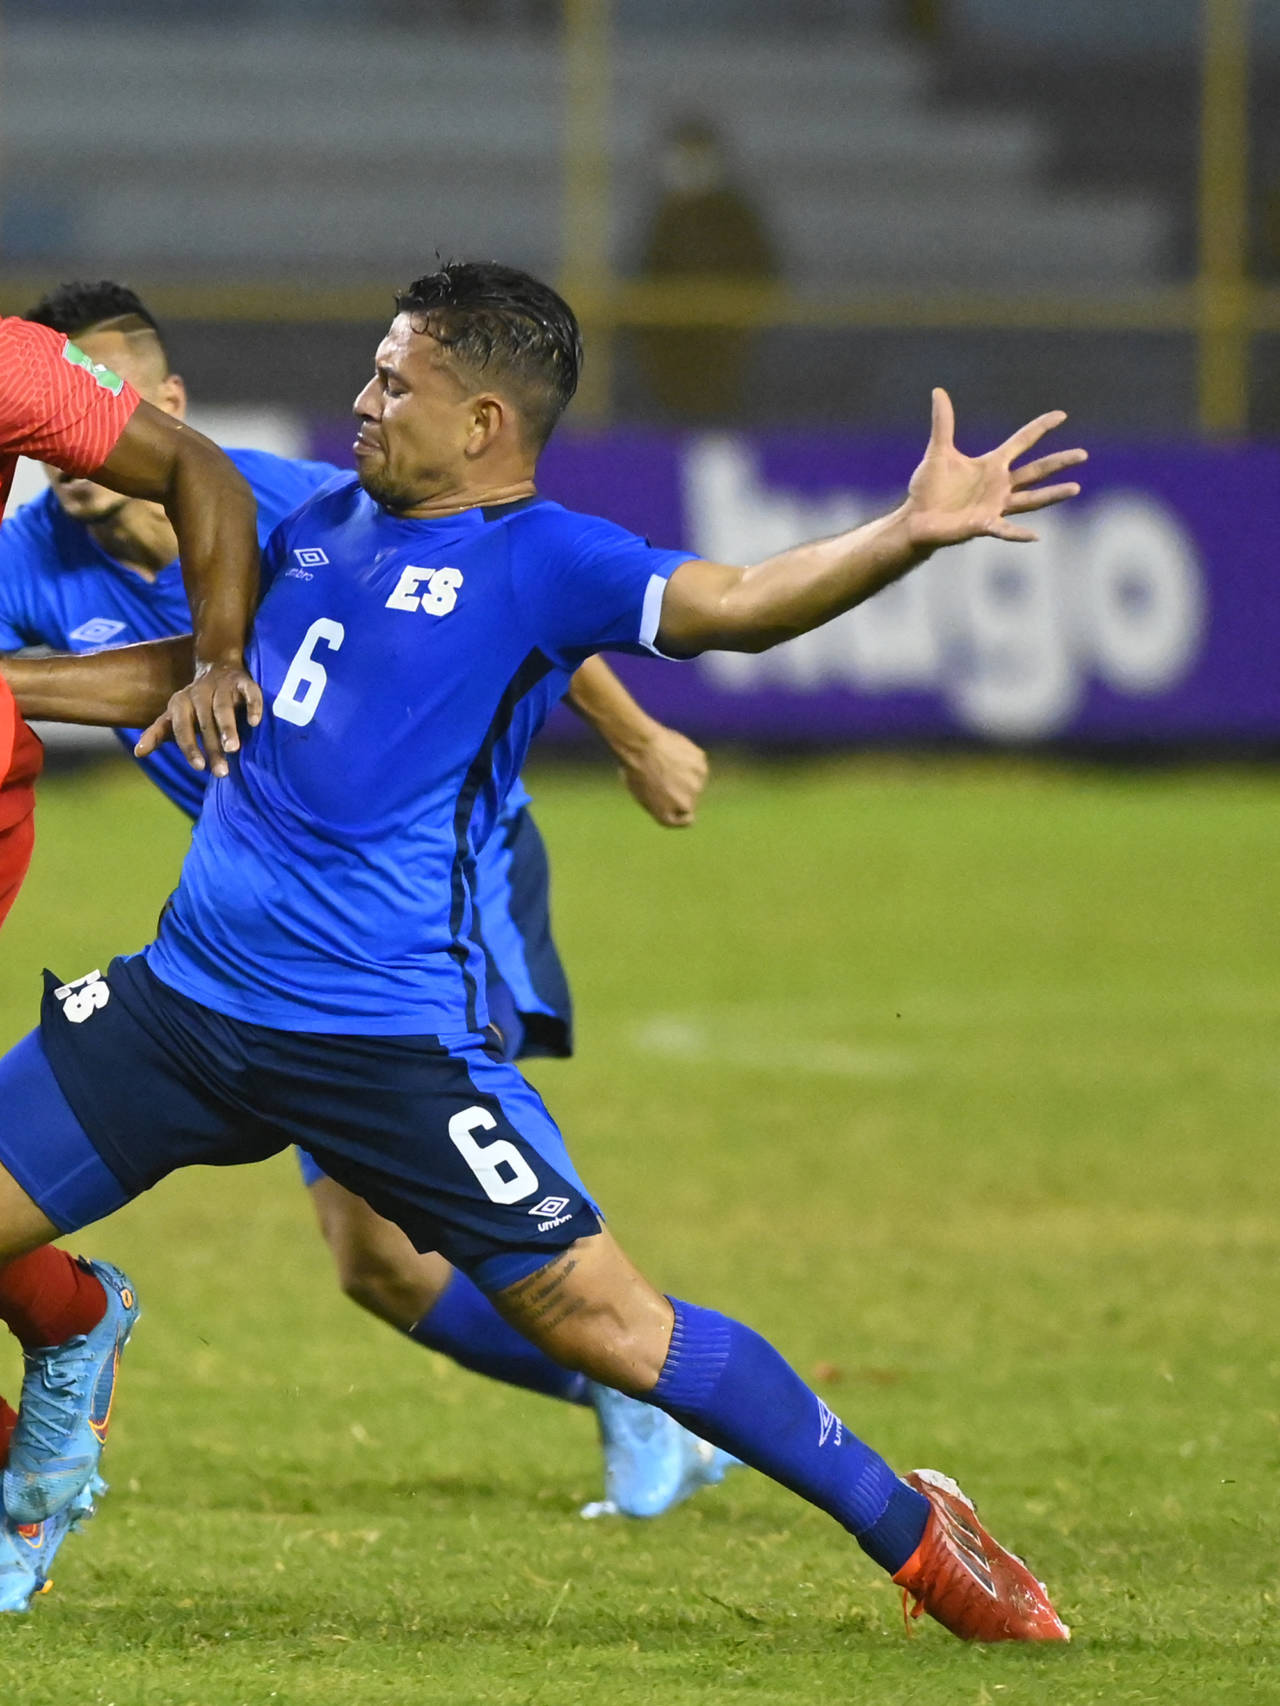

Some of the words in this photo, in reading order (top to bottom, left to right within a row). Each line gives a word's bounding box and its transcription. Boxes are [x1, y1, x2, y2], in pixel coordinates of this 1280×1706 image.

[384, 565, 464, 617] ES
[272, 617, 345, 727] 6
[448, 1105, 539, 1205] 6
